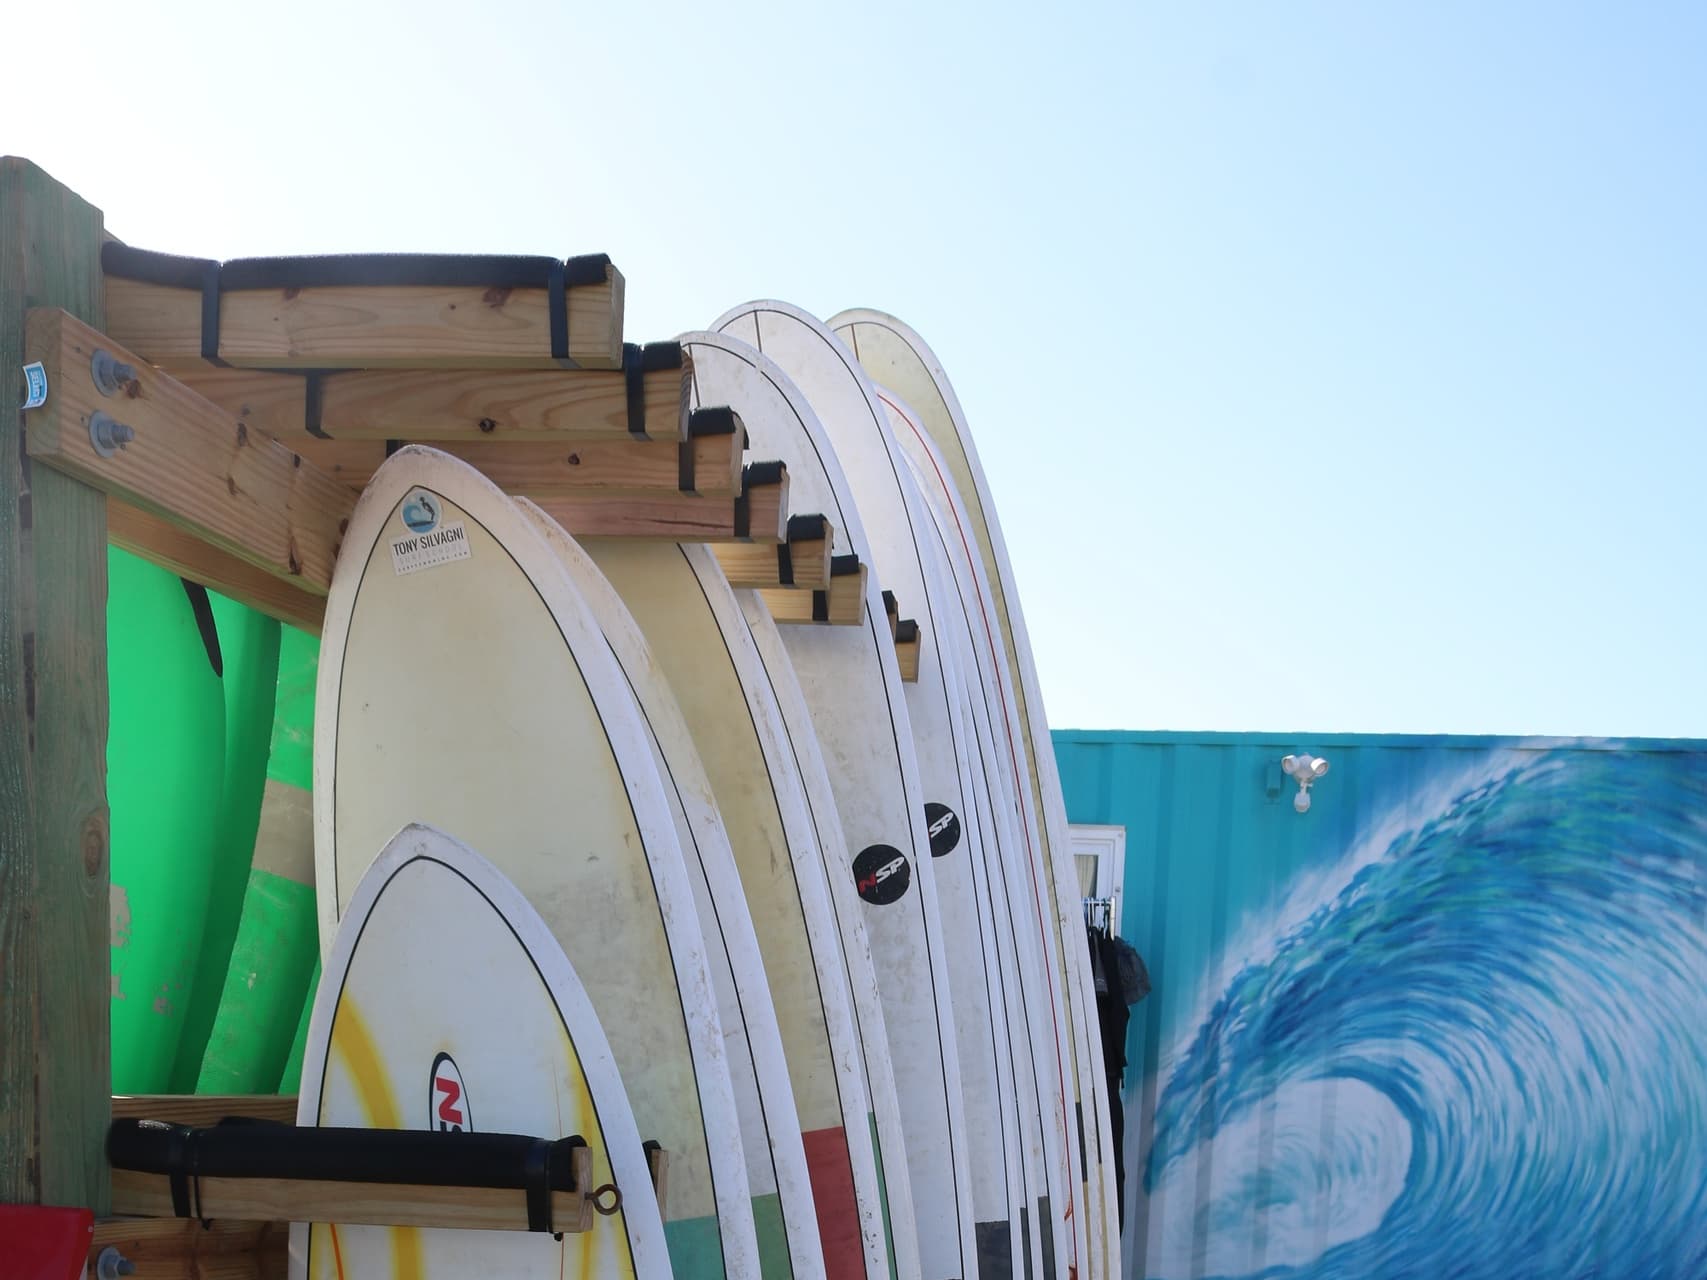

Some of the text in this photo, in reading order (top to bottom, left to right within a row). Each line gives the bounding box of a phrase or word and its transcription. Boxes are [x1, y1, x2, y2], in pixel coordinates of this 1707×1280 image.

[392, 538, 418, 557] TONY
[419, 527, 465, 550] SILVAGNI
[927, 811, 955, 839] SP
